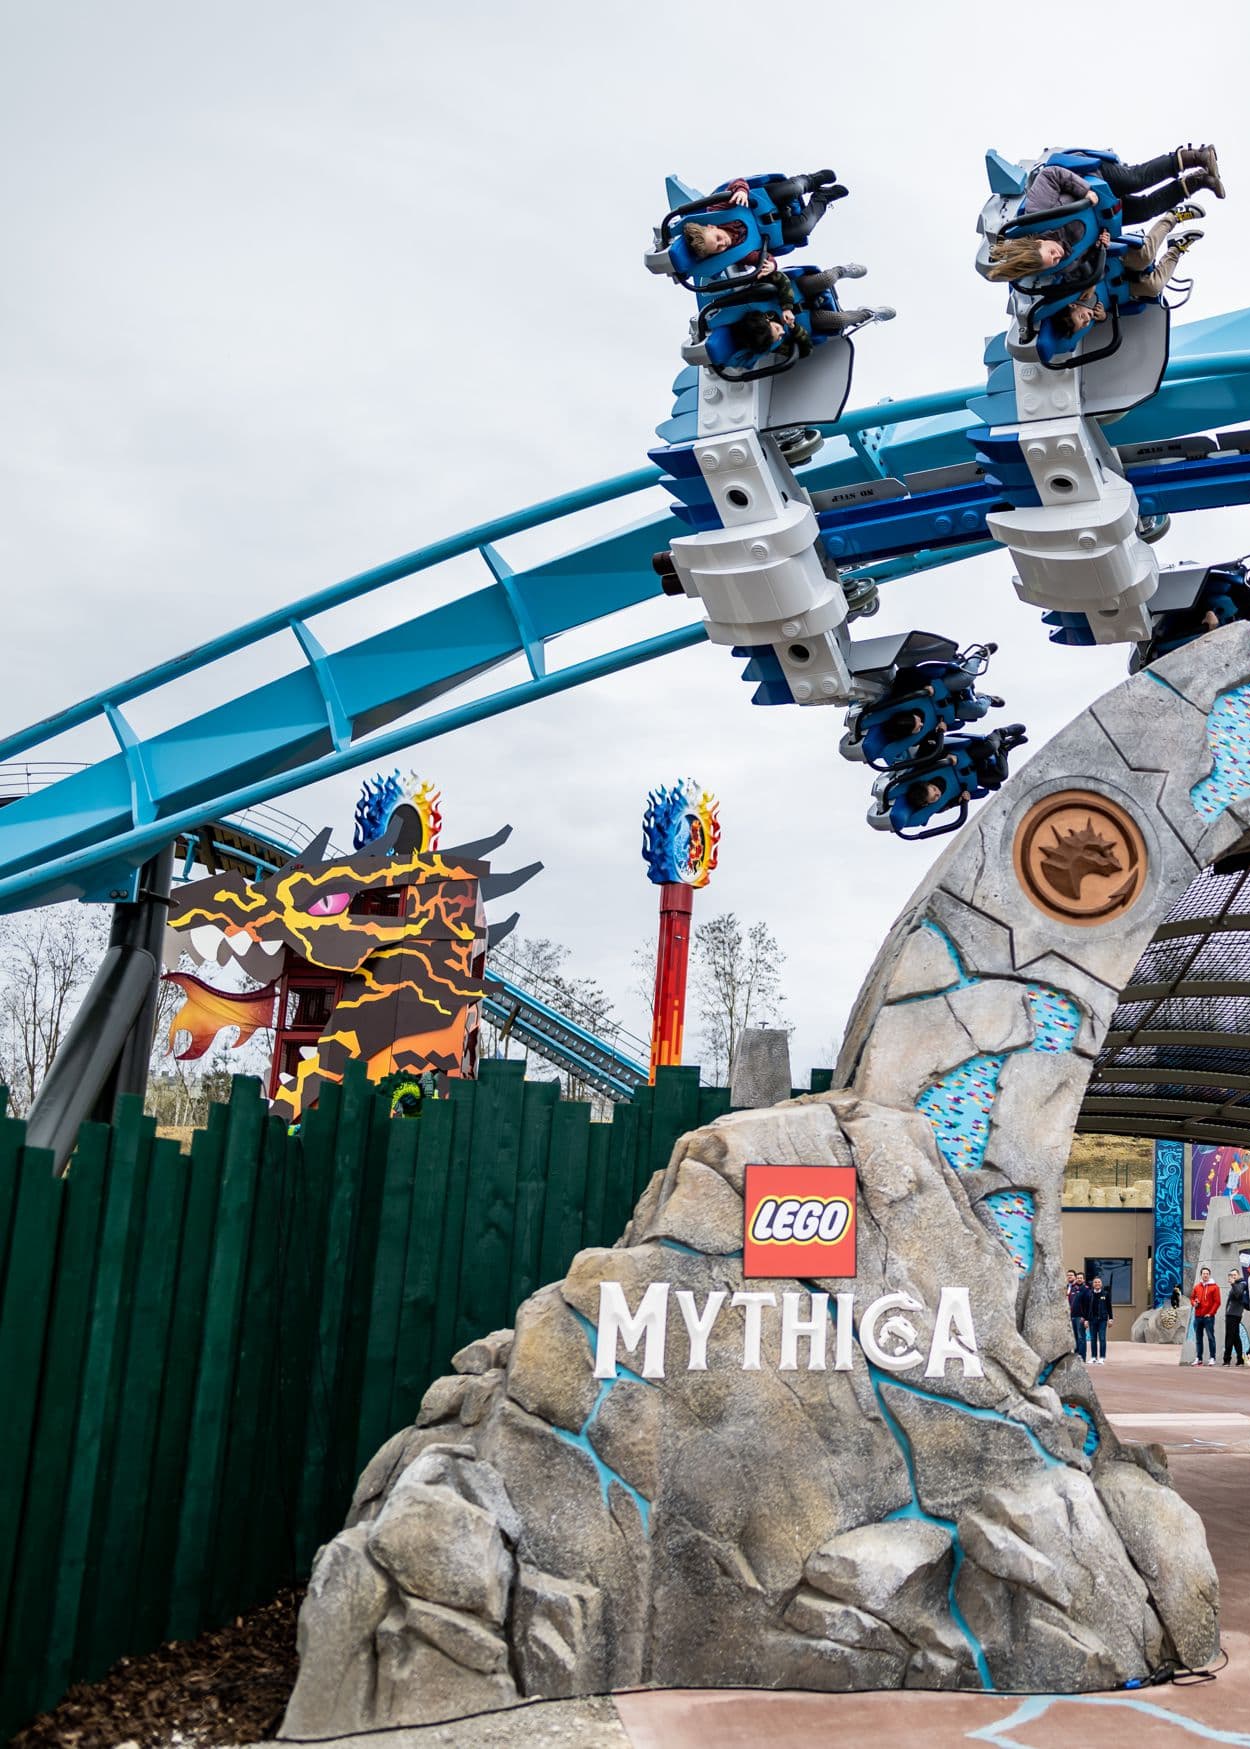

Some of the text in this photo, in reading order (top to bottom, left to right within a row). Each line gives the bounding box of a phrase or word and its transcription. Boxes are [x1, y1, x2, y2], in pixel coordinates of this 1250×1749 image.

[831, 488, 874, 503] NO STEP
[750, 1197, 852, 1244] LEGO
[593, 1281, 985, 1379] MYTHICA
